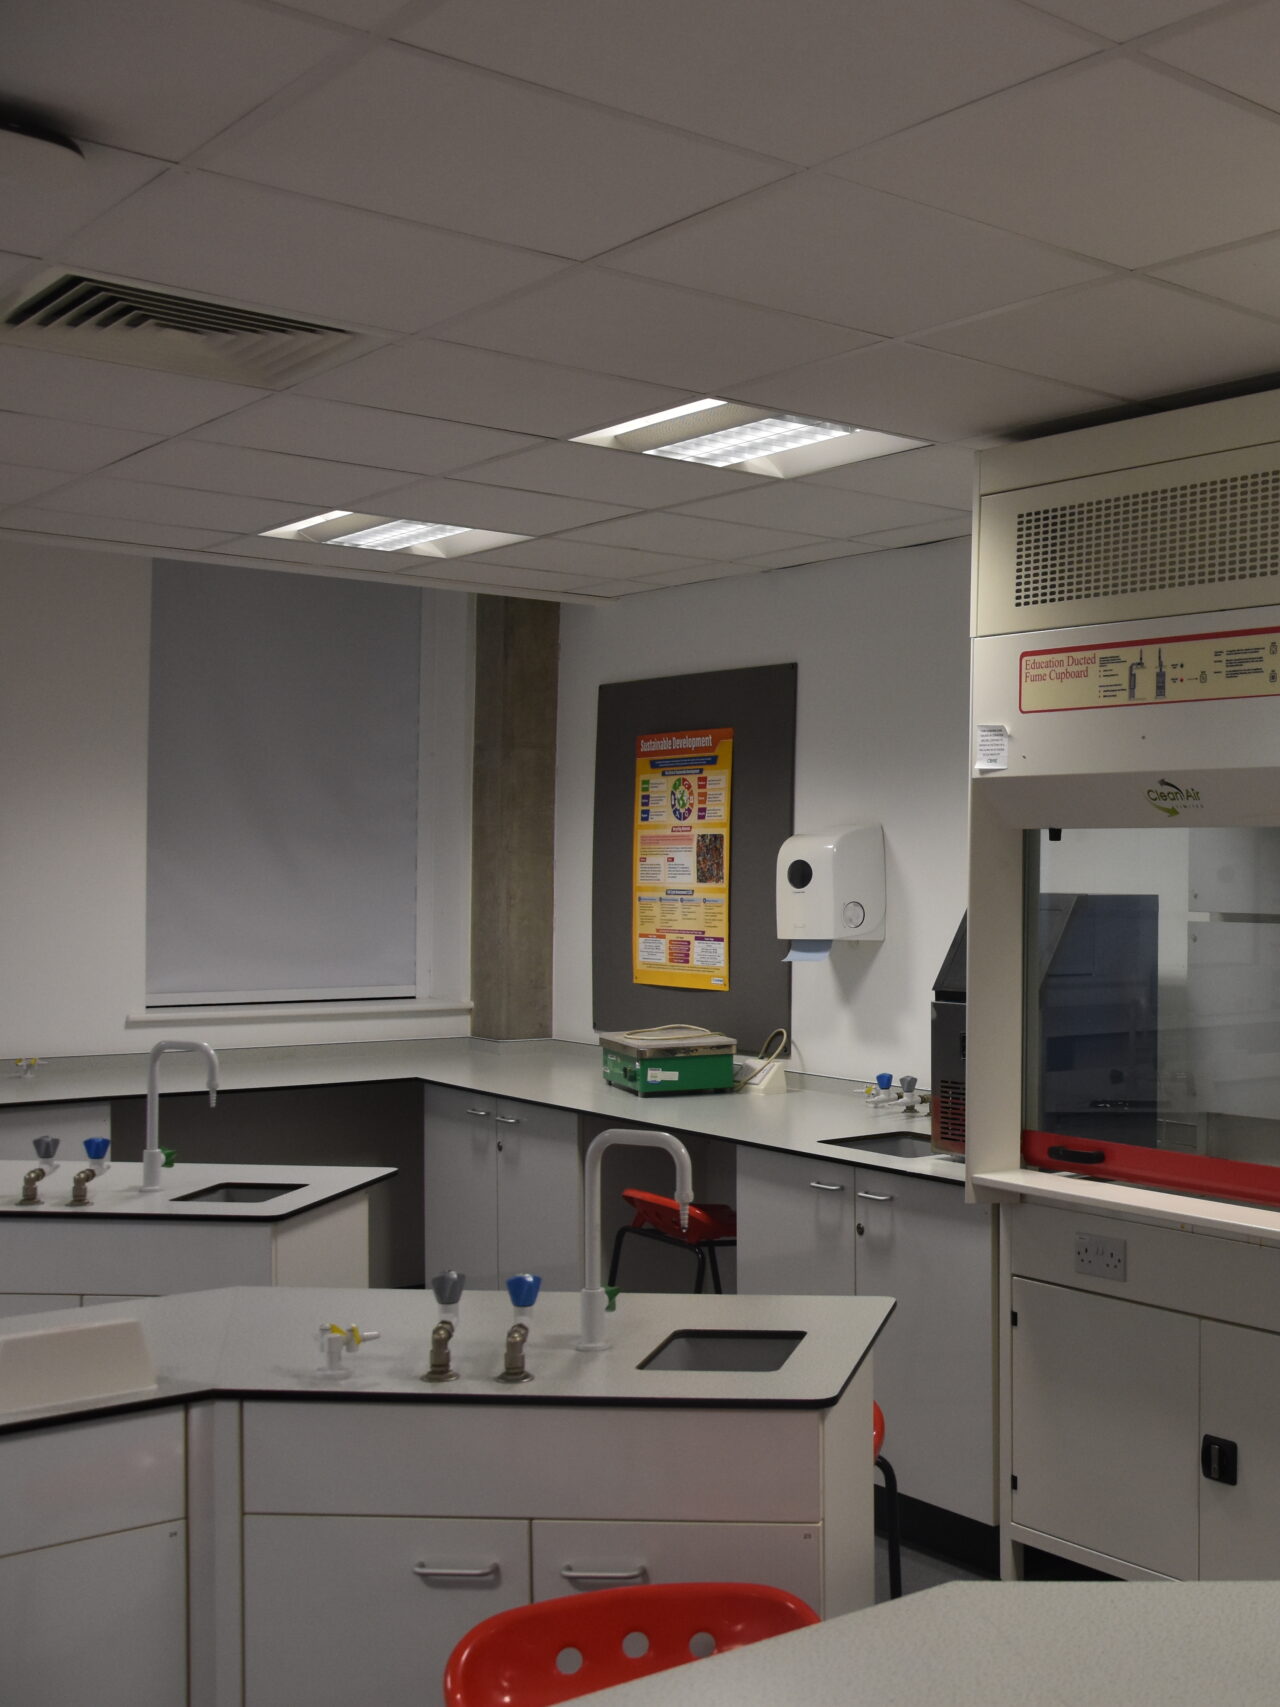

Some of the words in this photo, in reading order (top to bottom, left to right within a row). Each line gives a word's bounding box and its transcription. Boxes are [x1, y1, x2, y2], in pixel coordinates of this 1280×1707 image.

[1025, 657, 1064, 670] Education
[1067, 653, 1096, 666] Ducted
[1025, 671, 1046, 682] Fume
[1049, 666, 1089, 682] Cupboard
[640, 737, 672, 752] Sustainable
[672, 734, 713, 751] Development
